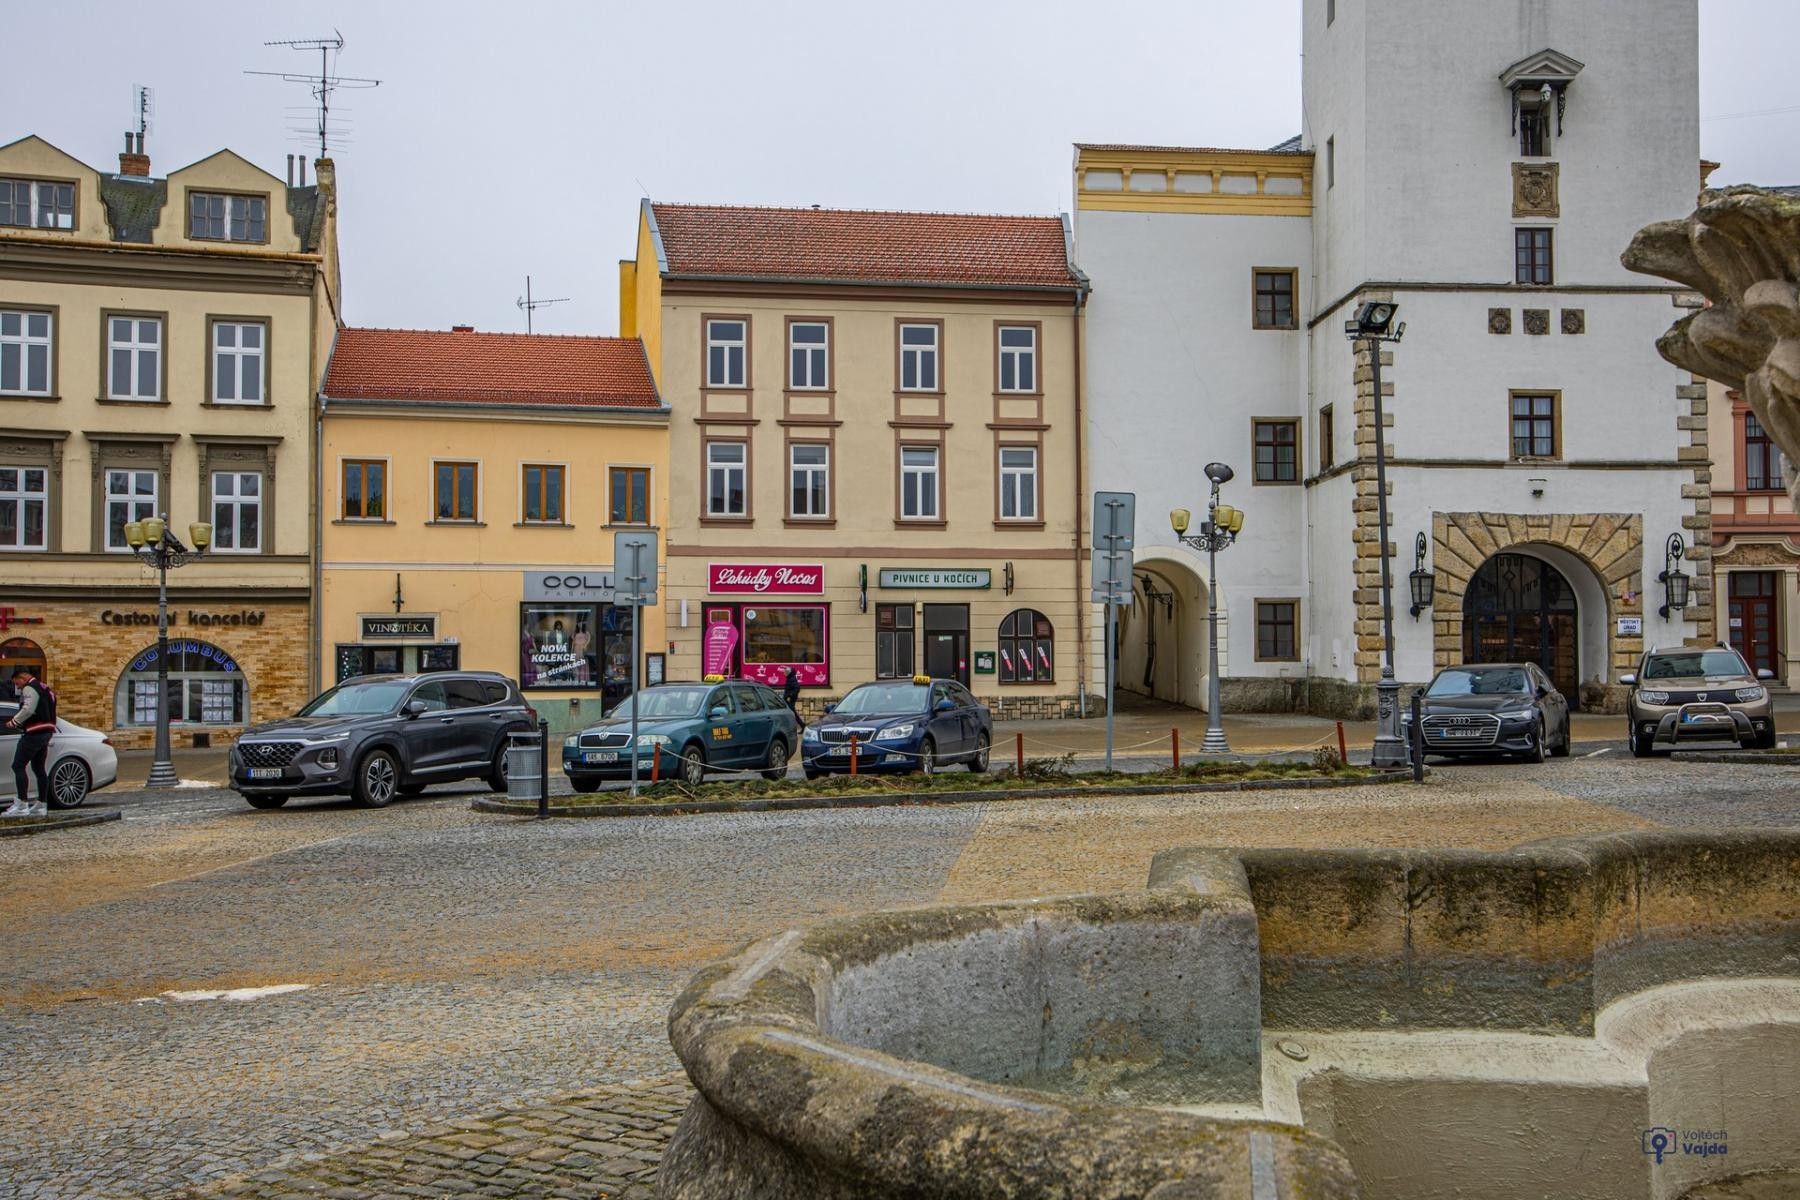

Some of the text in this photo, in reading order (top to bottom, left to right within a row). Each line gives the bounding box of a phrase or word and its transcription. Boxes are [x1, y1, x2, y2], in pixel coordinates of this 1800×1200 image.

[892, 573, 978, 584] PIVNICE U KOČÍCH
[188, 609, 267, 627] kancelář
[541, 642, 568, 653] NOVÁ
[133, 641, 237, 673] COUMBUS
[531, 653, 577, 663] KOLEKCE
[537, 658, 586, 679] na stránkách
